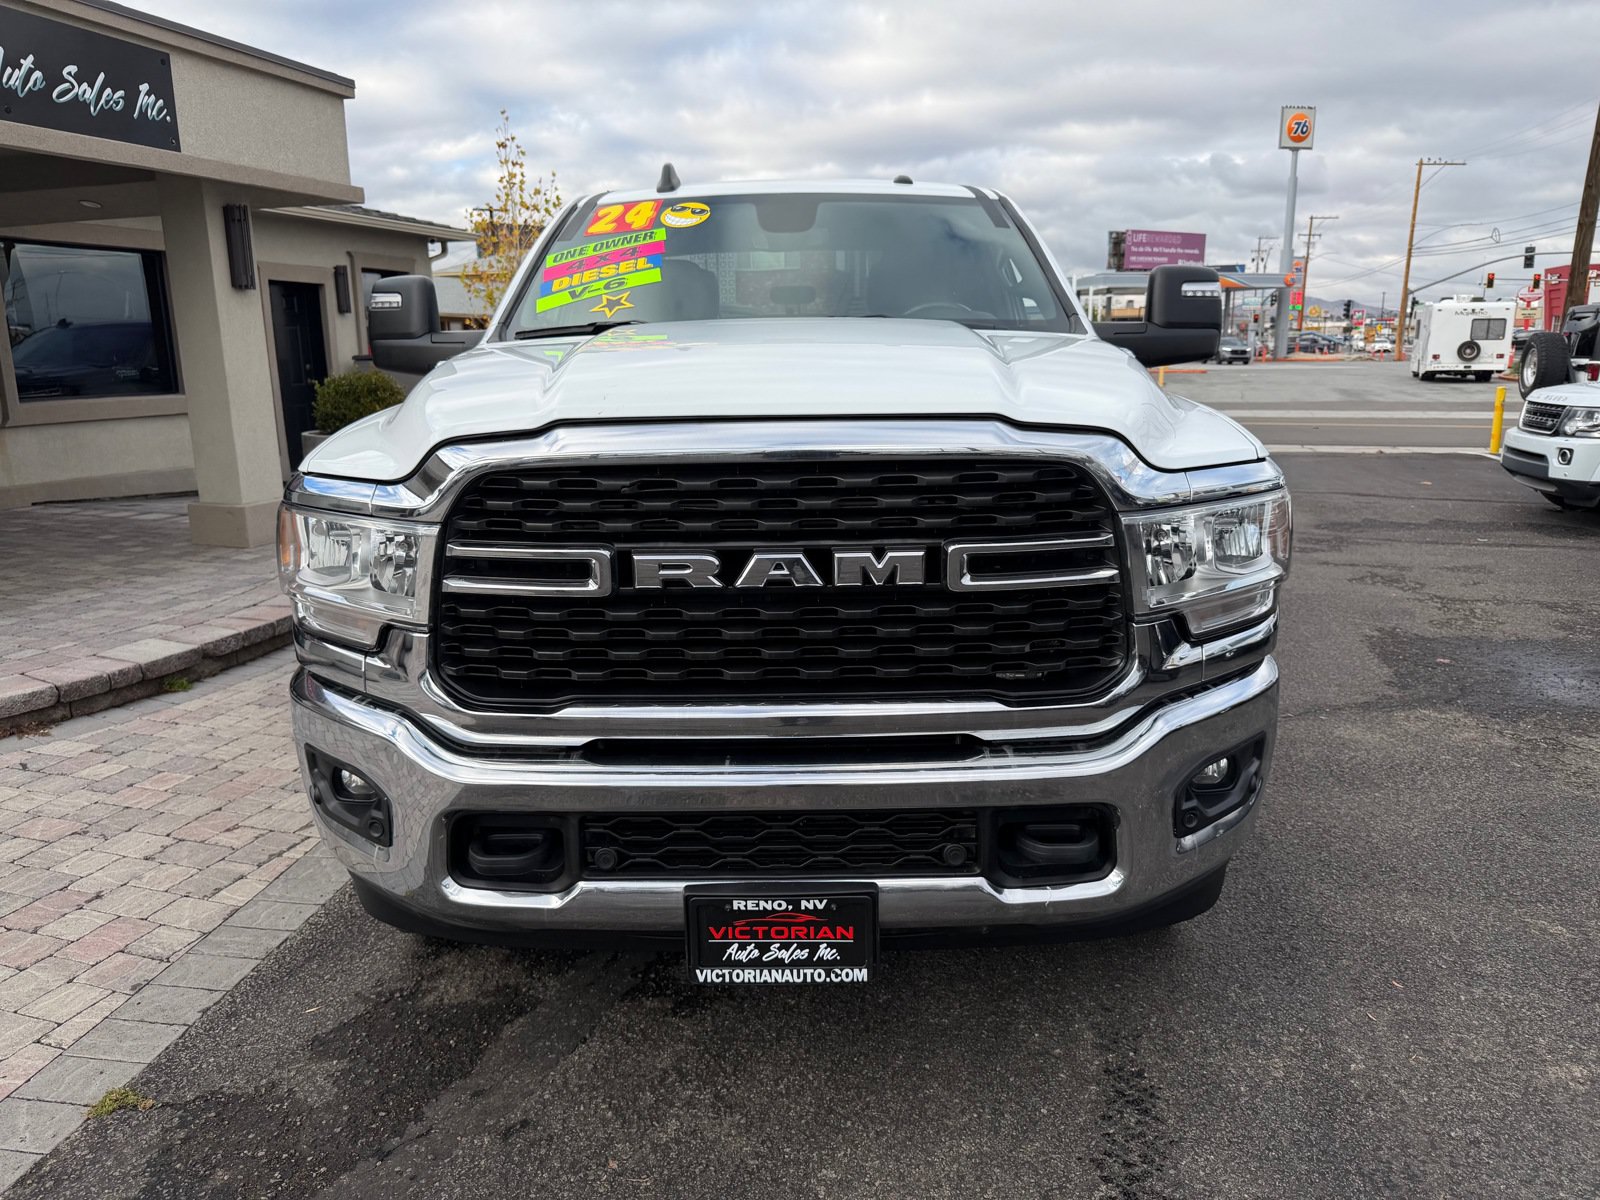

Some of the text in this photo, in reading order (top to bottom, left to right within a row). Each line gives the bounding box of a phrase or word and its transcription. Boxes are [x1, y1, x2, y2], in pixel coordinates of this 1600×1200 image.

[0, 46, 172, 123] uto Sales Inc.
[1291, 119, 1309, 136] 76
[587, 200, 658, 233] 24
[553, 231, 656, 264] ONE OWNER
[1133, 233, 1147, 243] LIFE
[552, 257, 654, 292] DIESEL
[568, 278, 628, 299] V-6
[632, 552, 926, 588] RAM
[732, 899, 828, 911] RENO, NV
[708, 926, 854, 939] VICTORIAN
[722, 943, 841, 964] Auto Sales Inc.
[695, 968, 868, 983] VICTORIANAUTO.COM
